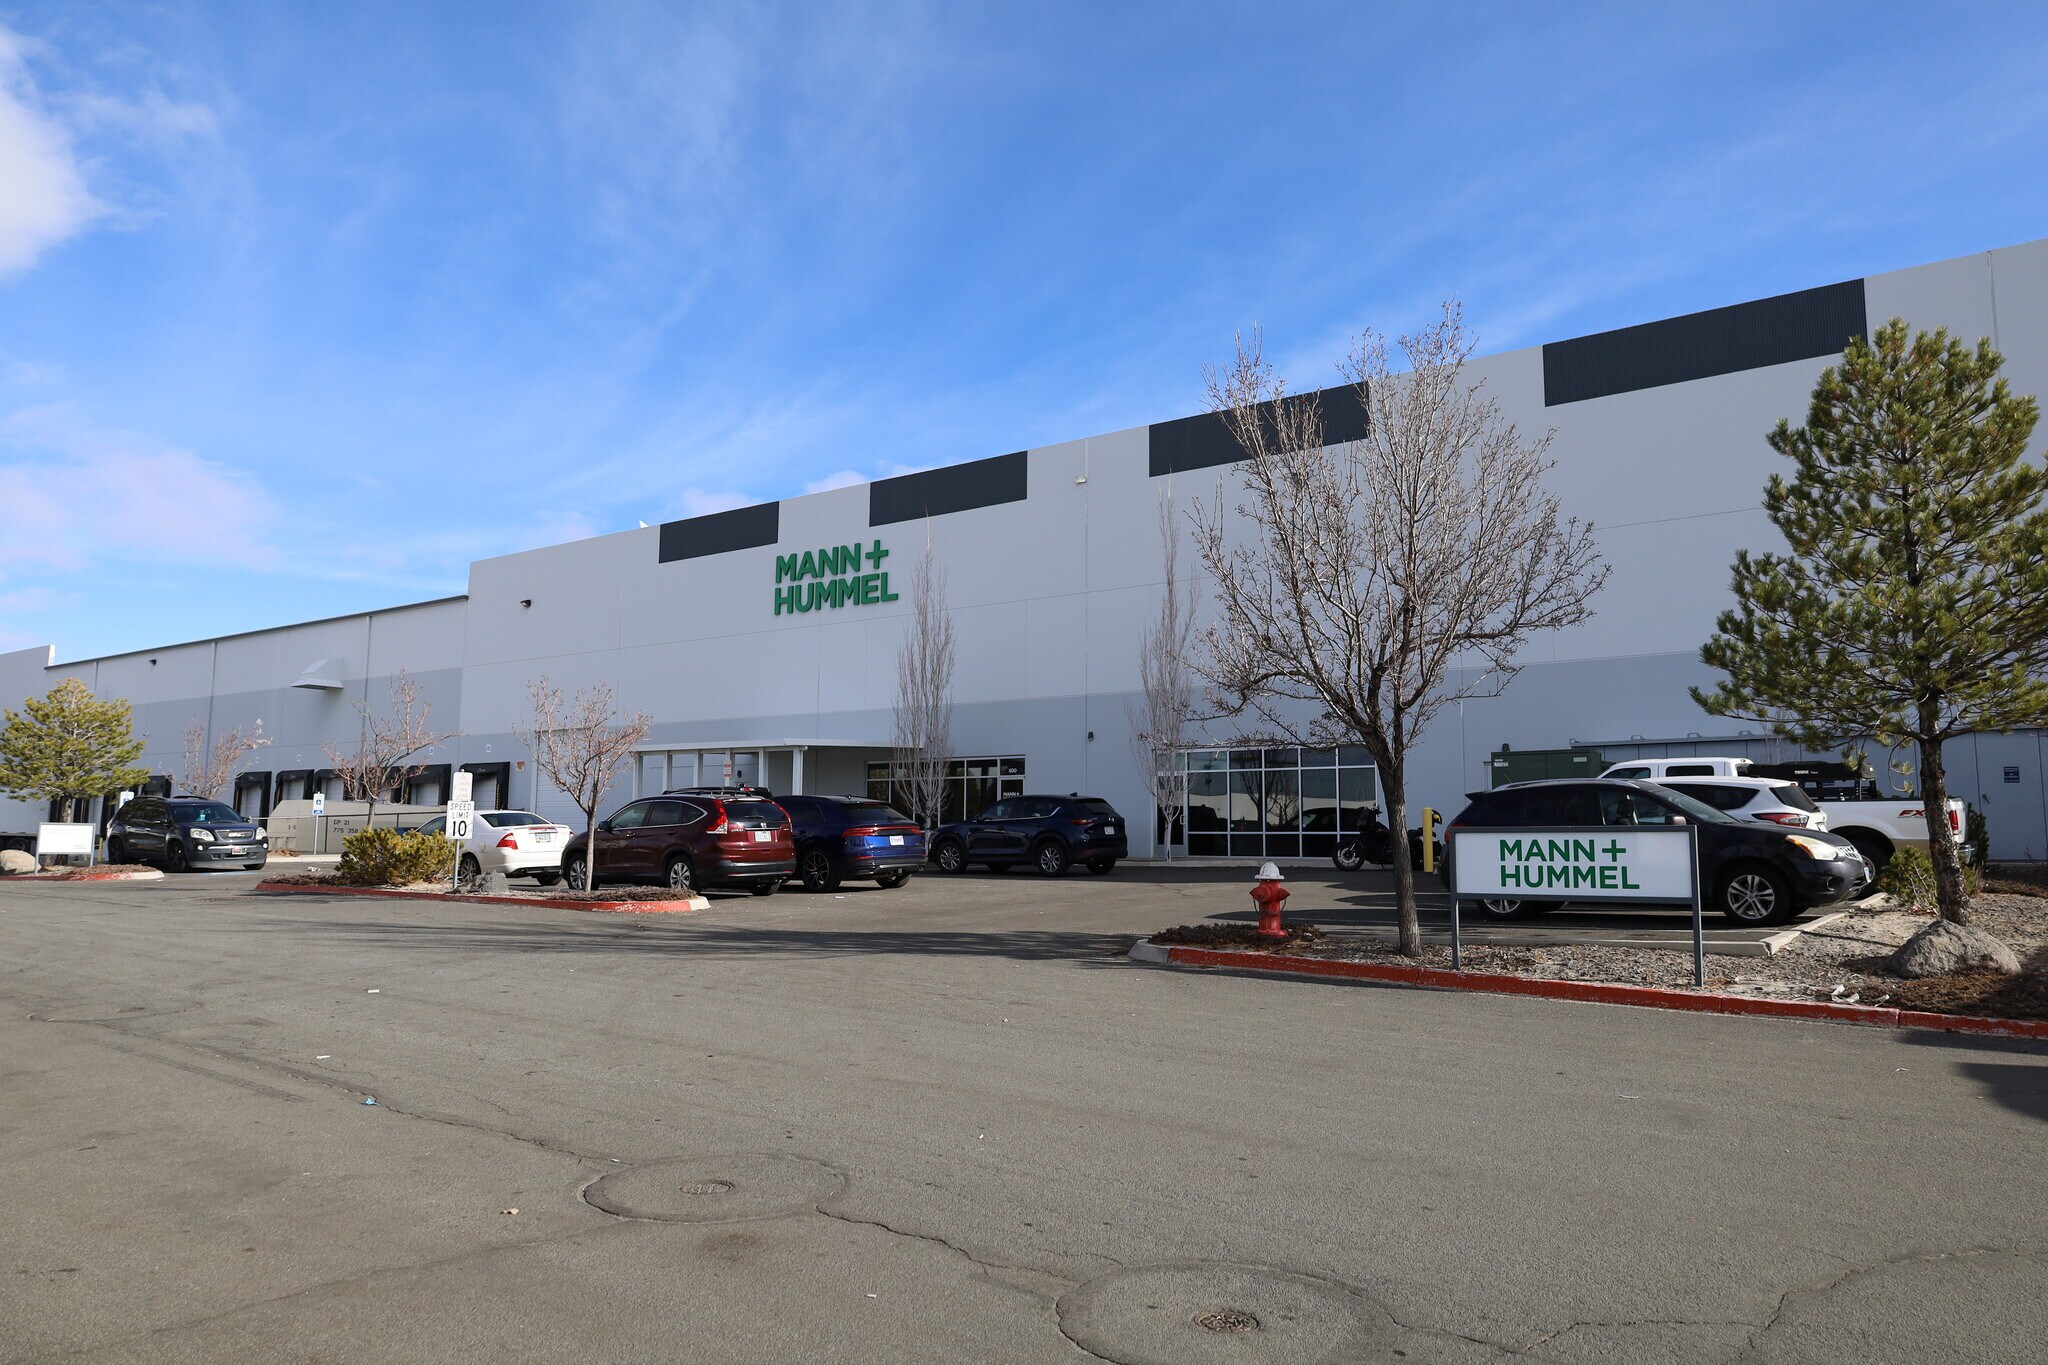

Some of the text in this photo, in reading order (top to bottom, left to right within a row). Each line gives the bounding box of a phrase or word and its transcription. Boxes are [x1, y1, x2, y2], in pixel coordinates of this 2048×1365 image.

[774, 572, 899, 615] HUMMEL
[450, 802, 472, 811] SPEED
[452, 811, 469, 819] LIMIT
[452, 820, 467, 837] 10
[1500, 864, 1640, 890] HUMMEL
